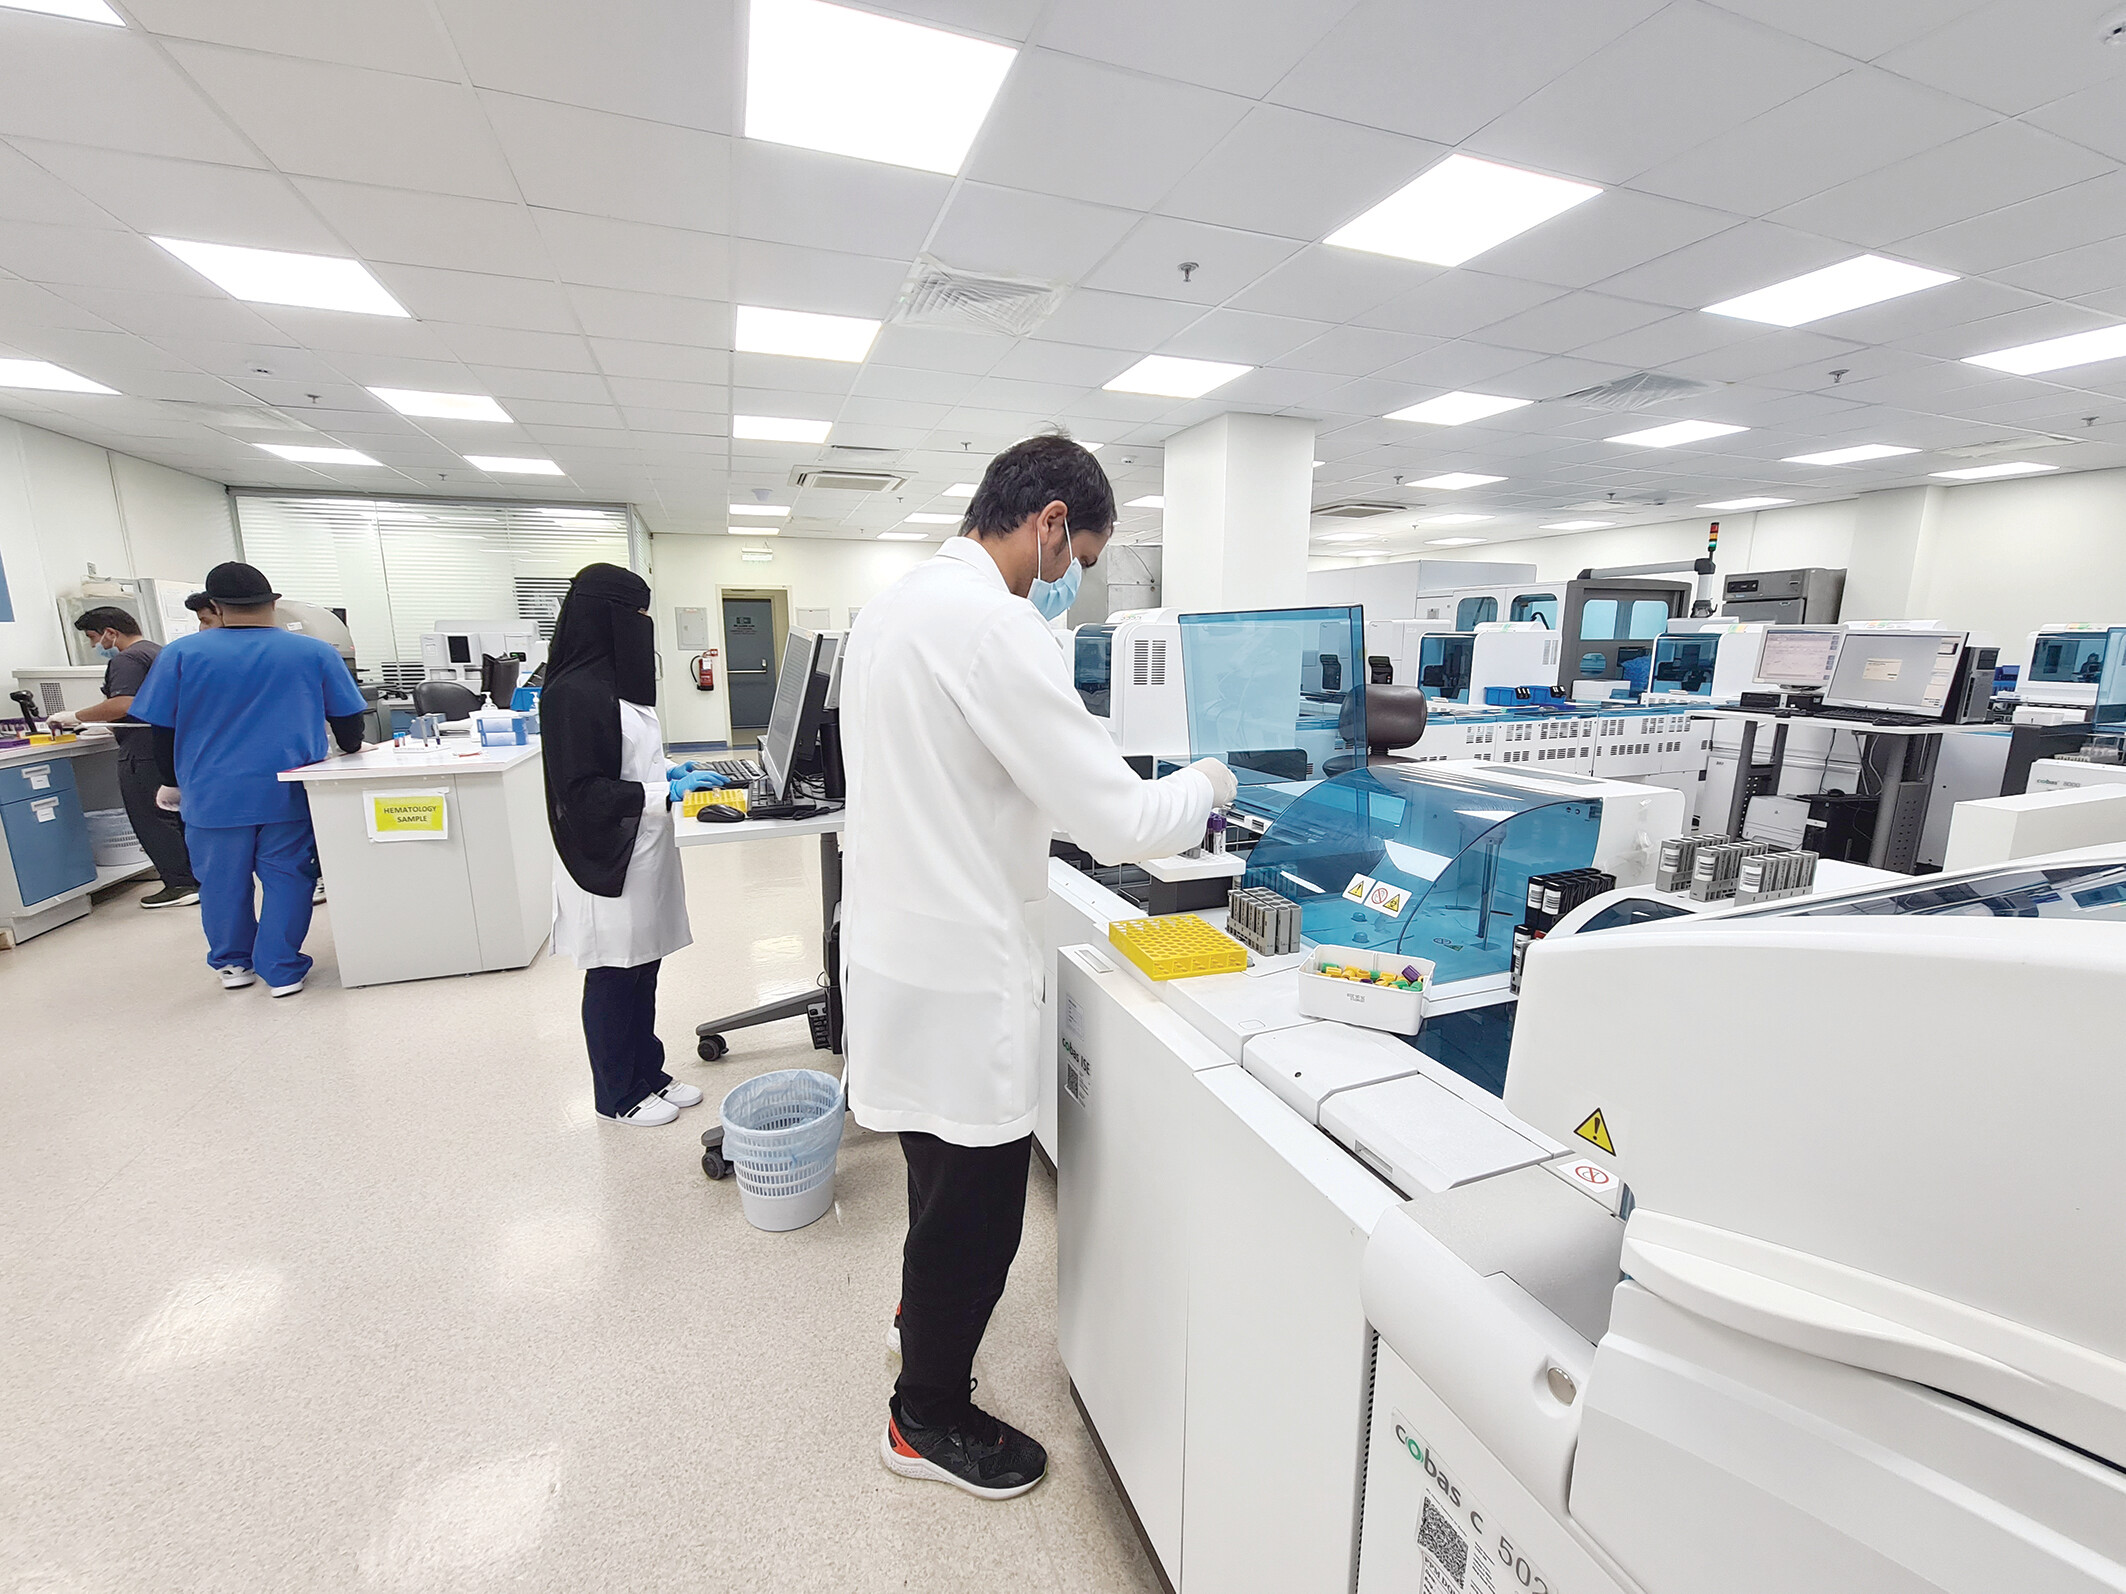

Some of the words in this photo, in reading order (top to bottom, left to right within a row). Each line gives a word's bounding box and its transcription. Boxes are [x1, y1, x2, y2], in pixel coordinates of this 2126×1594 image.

[383, 805, 437, 814] HEMATOLOGY
[397, 815, 428, 823] SAMPLE
[1062, 1038, 1080, 1063] cobas
[1395, 1424, 1462, 1508] cobas
[1470, 1510, 1484, 1535] c
